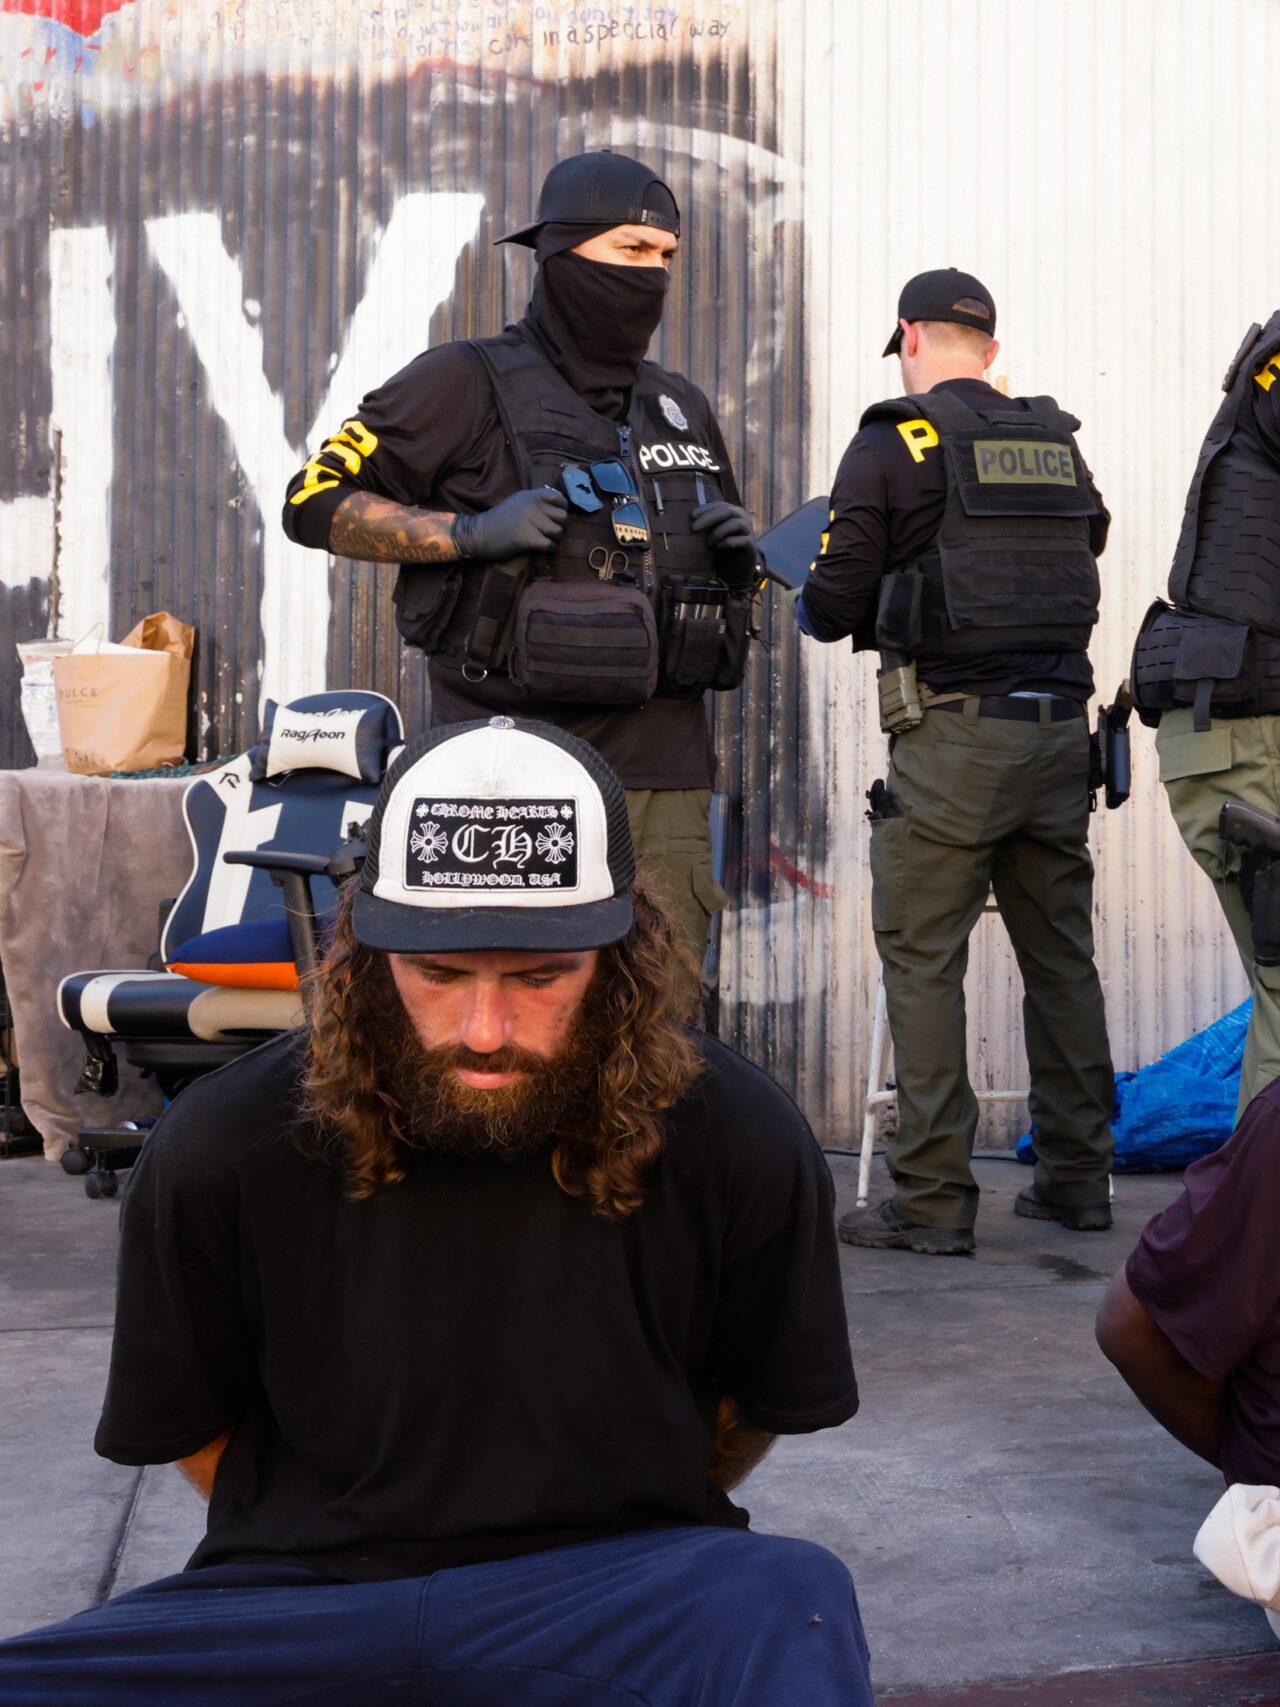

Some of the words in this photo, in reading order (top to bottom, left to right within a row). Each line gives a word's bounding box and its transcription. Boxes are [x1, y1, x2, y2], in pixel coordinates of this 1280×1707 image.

[639, 442, 720, 470] POLICE
[979, 446, 1073, 480] POLICE
[452, 824, 533, 869] CH
[528, 872, 562, 887] USA
